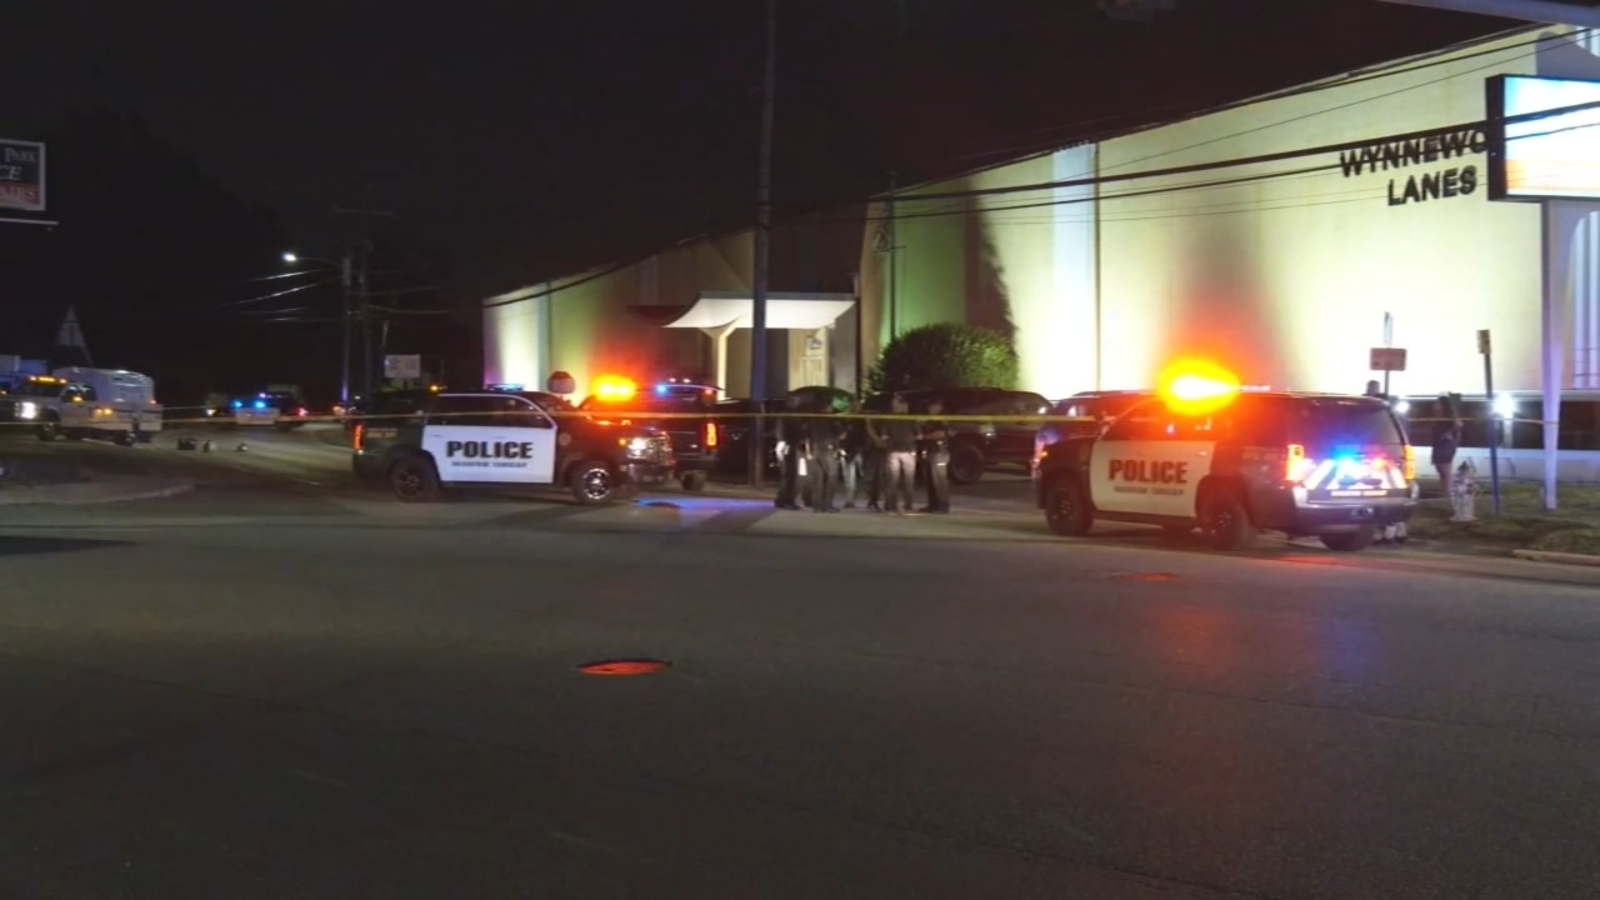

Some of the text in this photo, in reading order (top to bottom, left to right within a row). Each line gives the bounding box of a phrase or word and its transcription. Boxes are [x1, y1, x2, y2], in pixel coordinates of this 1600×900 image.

[1388, 165, 1477, 206] LANES
[446, 441, 534, 459] POLICE
[1109, 459, 1188, 484] POLICE
